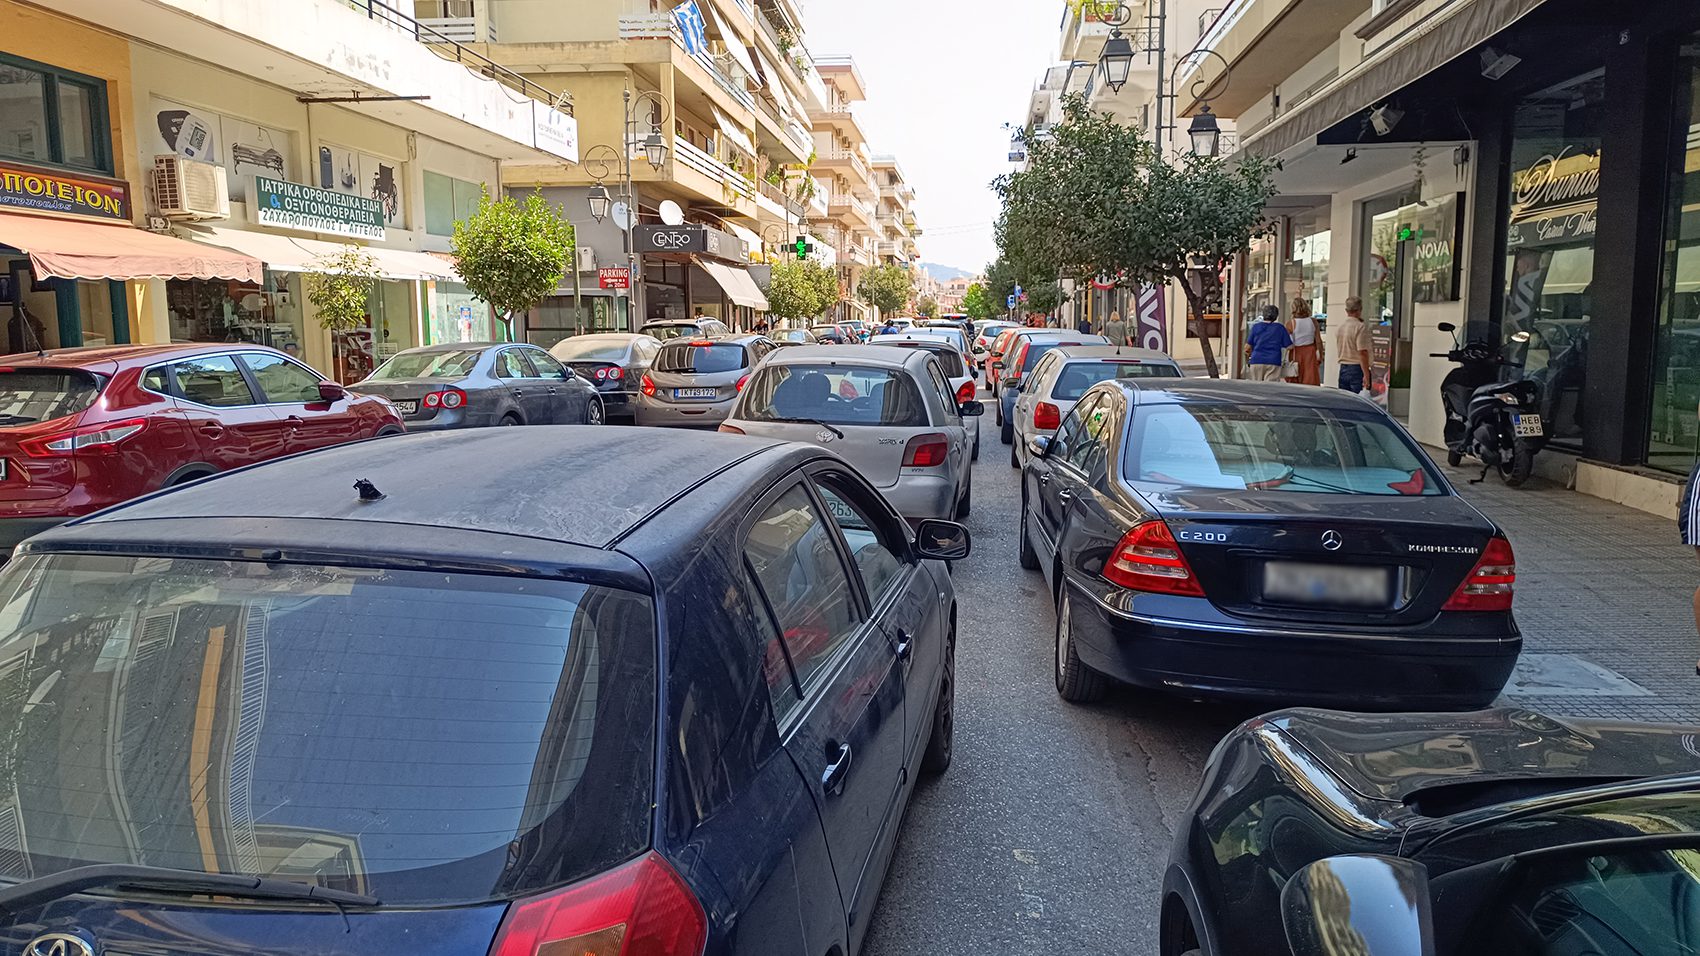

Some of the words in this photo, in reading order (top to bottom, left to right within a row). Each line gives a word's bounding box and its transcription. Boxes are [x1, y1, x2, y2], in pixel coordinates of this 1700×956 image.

[0, 172, 121, 217] ΠΟΙΕΙΟΝ
[0, 194, 72, 211] στοπουλος
[260, 178, 301, 198] ΙΑΤΡΙΚΑ
[302, 188, 361, 210] ΟΡΘΟΠΕΔΙΚΑ
[361, 198, 380, 213] ΕΙΔΗ
[284, 197, 375, 224] ΟΞΥΓΟΝΟΘΕΡΑΠΕΙΑ
[262, 208, 336, 231] ΖΑΧΑΡΟΠΟΥΛΟΣ
[348, 223, 383, 238] ΑΓΓΕΛΟΣ
[652, 231, 691, 247] CENTRO
[1415, 240, 1451, 260] NOVA
[599, 268, 628, 278] PARKING
[1138, 278, 1164, 352] OVA
[830, 502, 852, 517] 263
[1180, 531, 1189, 540] C
[1193, 532, 1227, 542] 200
[1408, 544, 1479, 554] KOMPRESSOR
